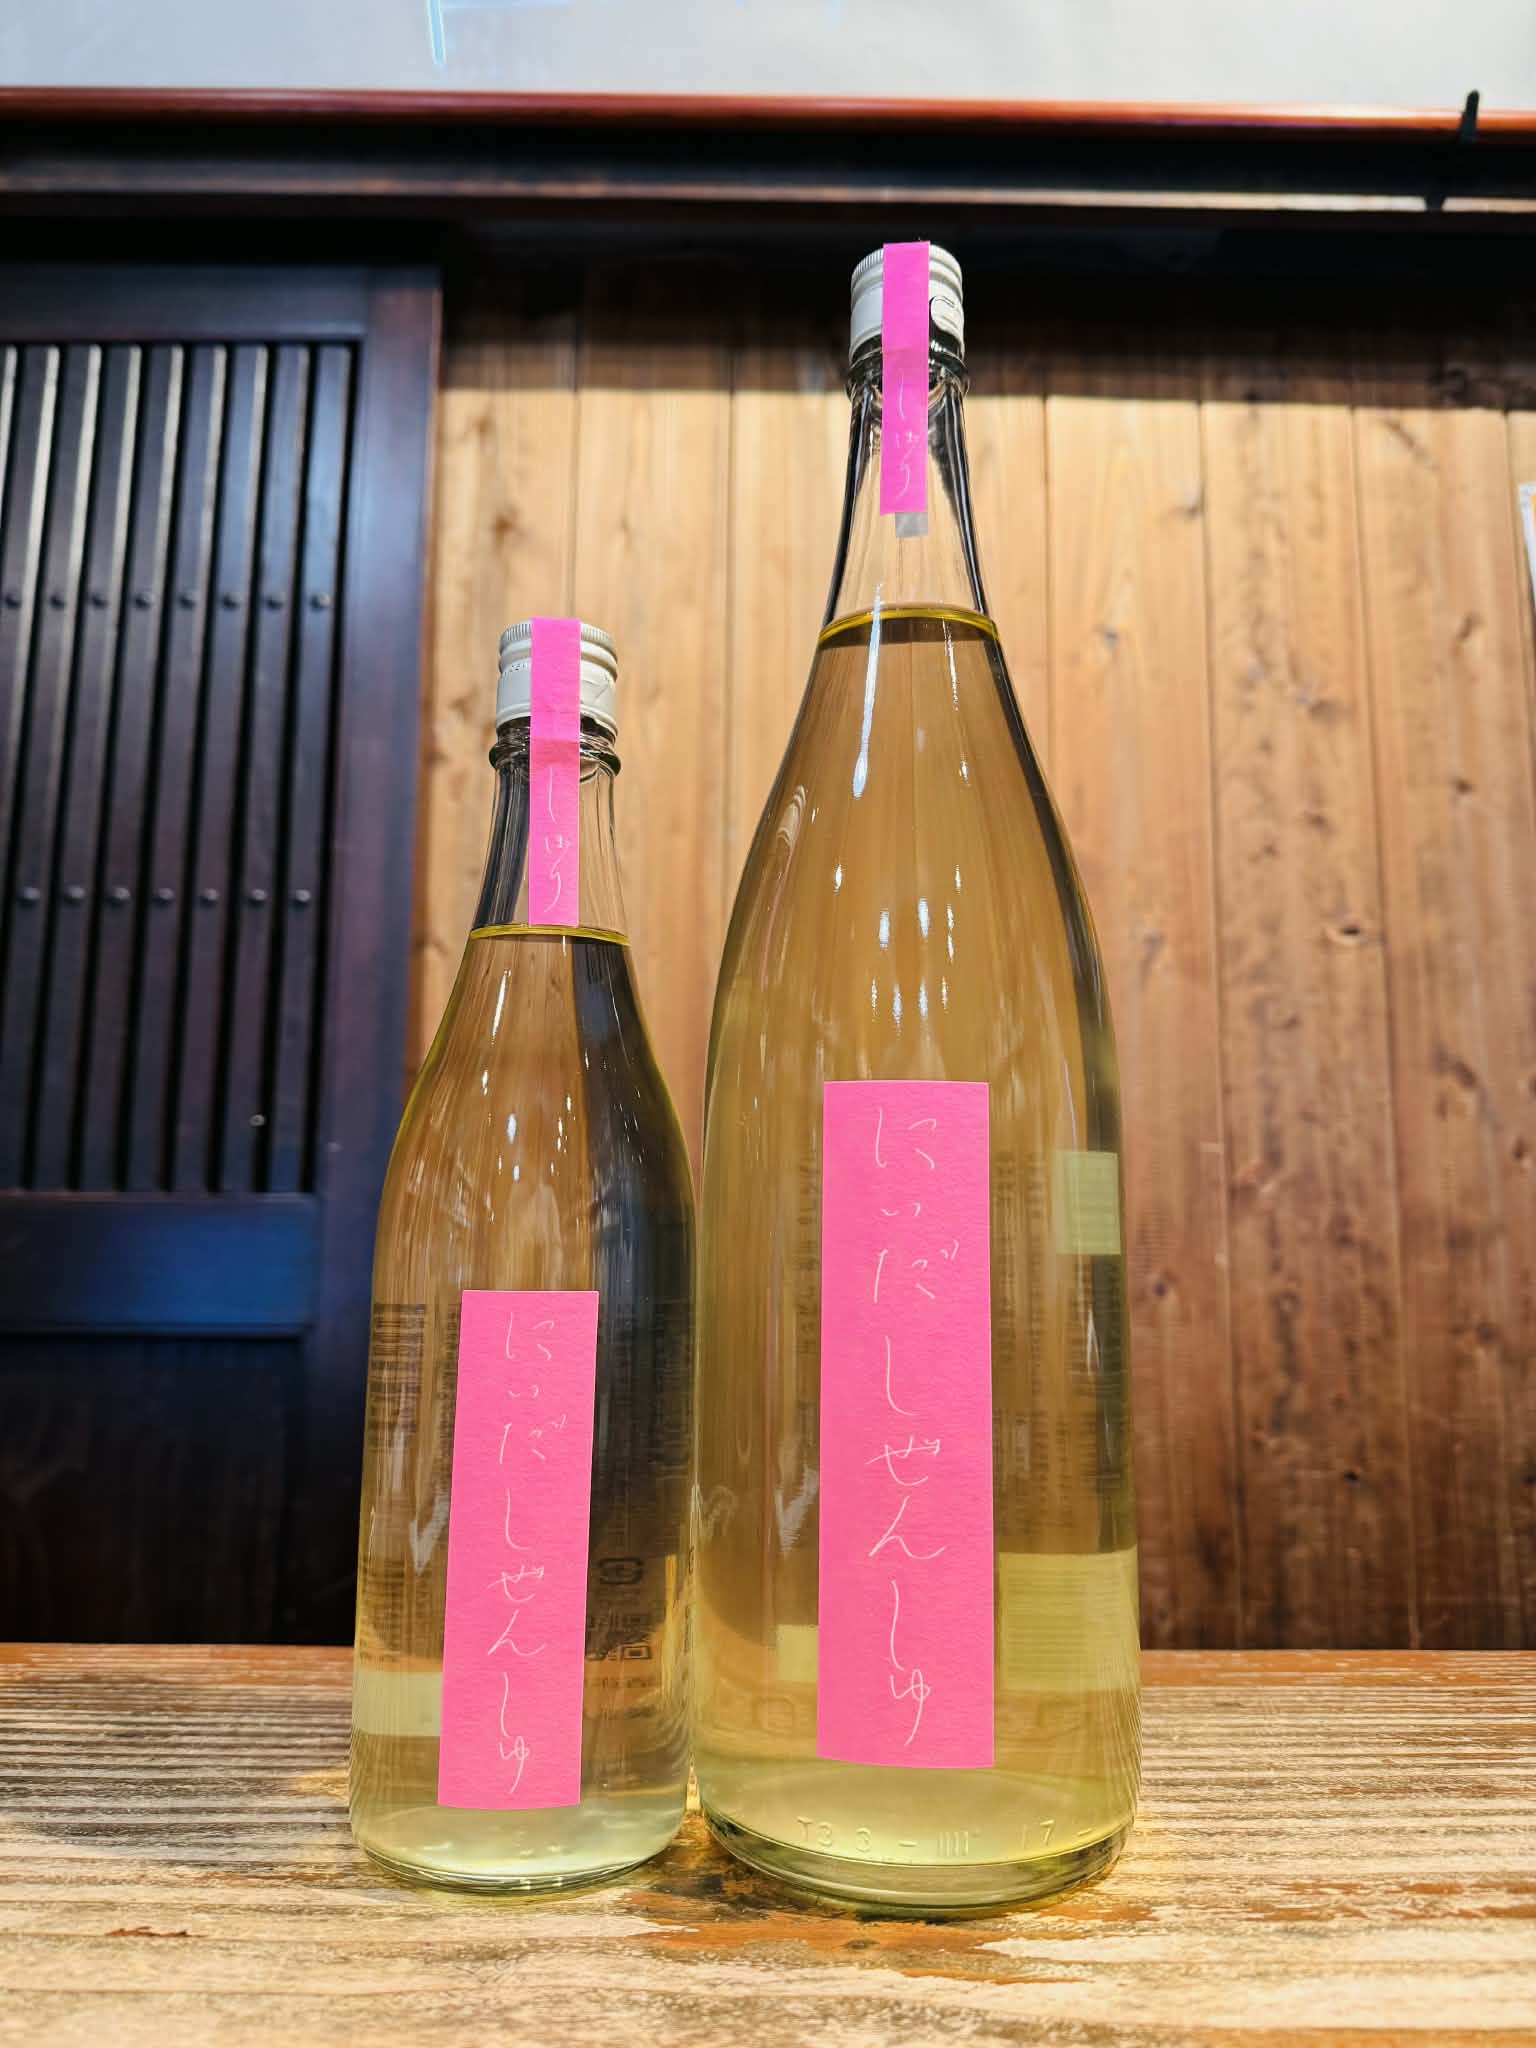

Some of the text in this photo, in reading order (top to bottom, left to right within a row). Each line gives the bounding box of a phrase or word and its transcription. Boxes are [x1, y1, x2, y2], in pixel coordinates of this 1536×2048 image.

[487, 1311, 567, 1794] にいだしぜんしゅ
[865, 1107, 960, 1748] にいだしぜんしゅ
